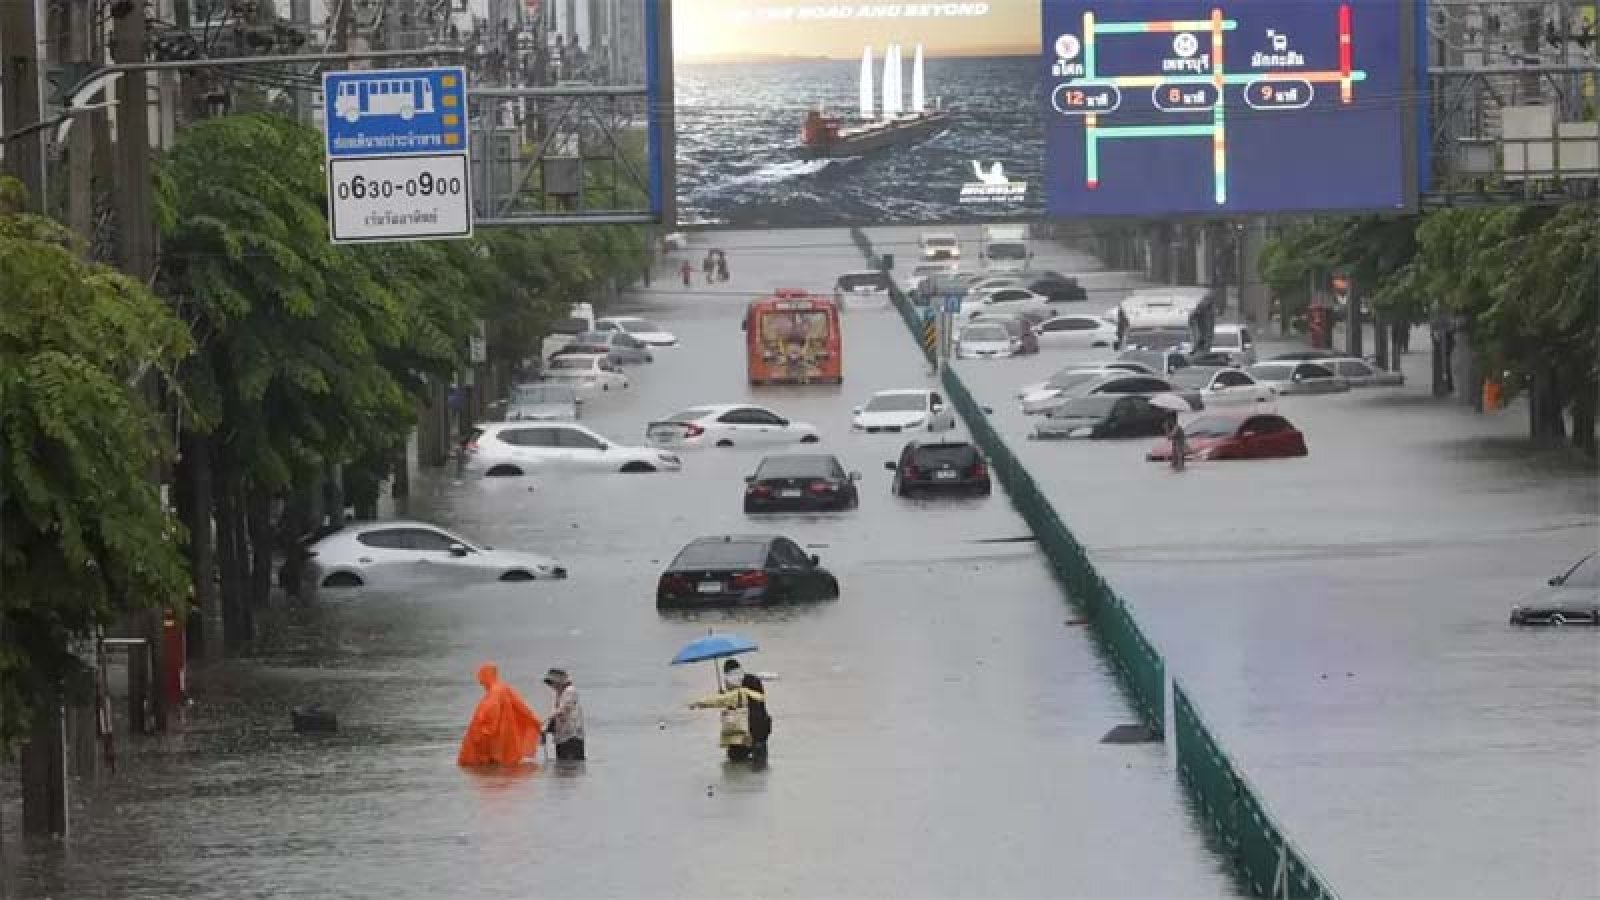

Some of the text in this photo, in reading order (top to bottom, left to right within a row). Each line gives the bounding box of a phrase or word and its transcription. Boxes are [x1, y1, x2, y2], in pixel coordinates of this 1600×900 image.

[855, 4, 900, 17] AND
[903, 2, 990, 16] BEYOND
[1065, 91, 1084, 105] 12
[1169, 88, 1180, 103] 8
[1261, 85, 1273, 101] 9
[338, 171, 461, 200] 0630-0900
